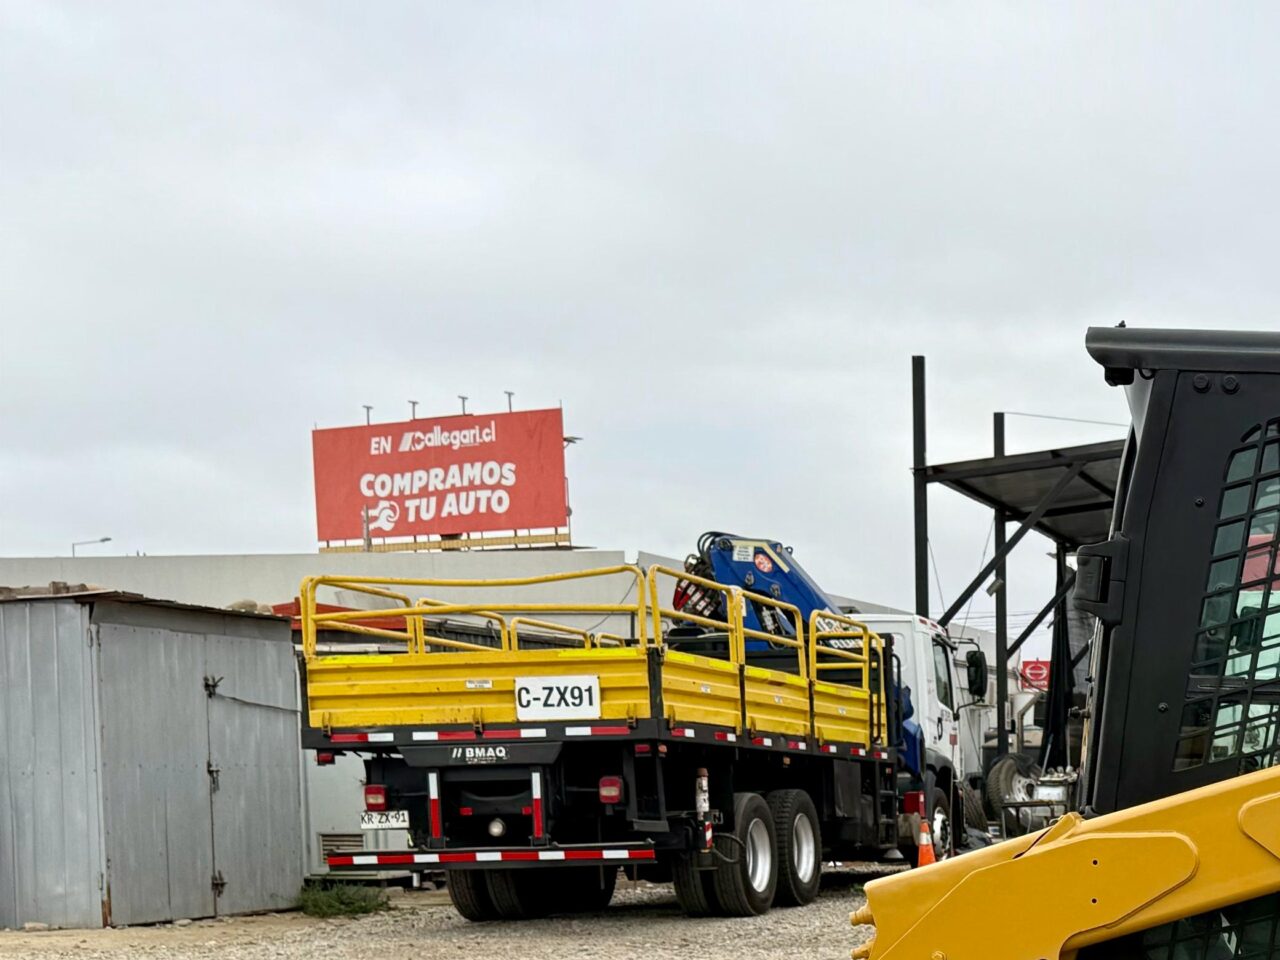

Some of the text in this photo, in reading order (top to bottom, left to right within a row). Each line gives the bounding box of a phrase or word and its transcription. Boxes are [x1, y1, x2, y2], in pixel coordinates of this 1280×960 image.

[370, 436, 391, 455] EN
[360, 461, 516, 497] COMPRAMOS
[405, 489, 510, 522] TU AUTO
[517, 686, 594, 708] C-ZX91
[465, 746, 507, 758] BMAQ
